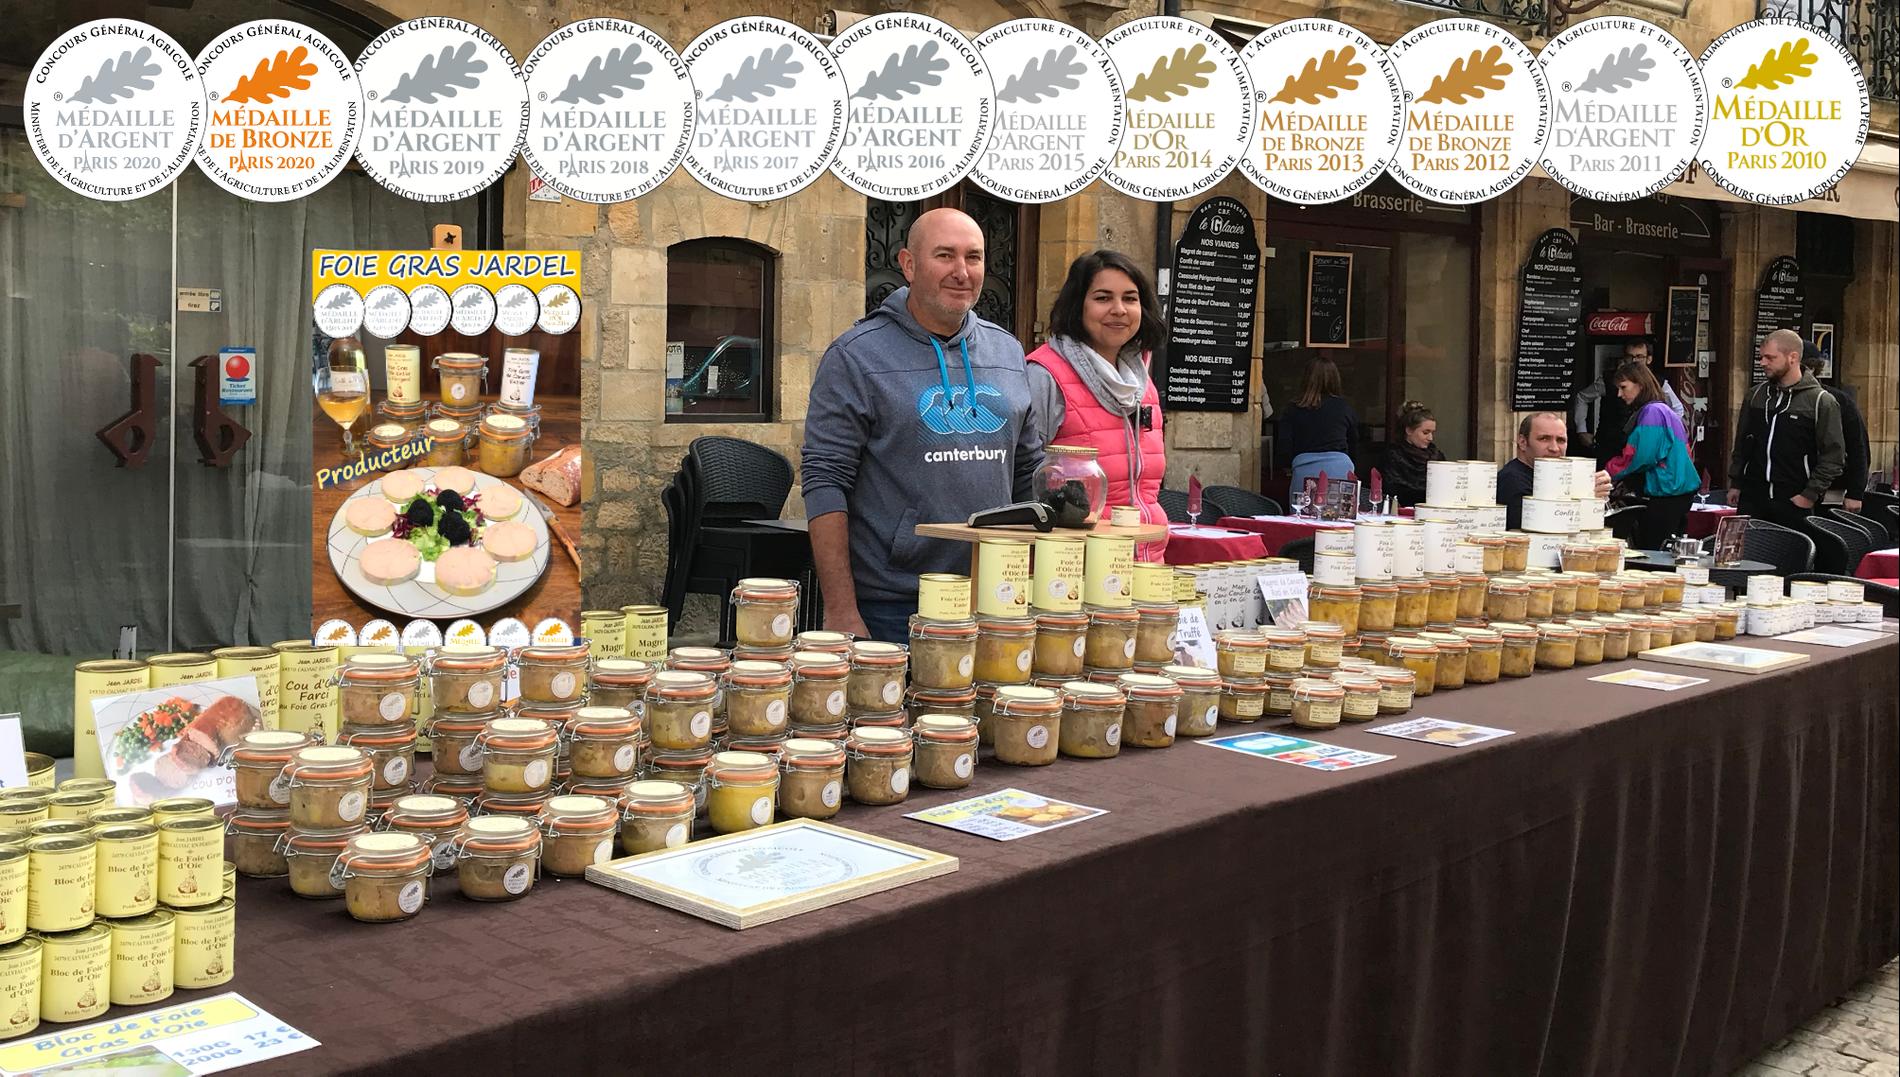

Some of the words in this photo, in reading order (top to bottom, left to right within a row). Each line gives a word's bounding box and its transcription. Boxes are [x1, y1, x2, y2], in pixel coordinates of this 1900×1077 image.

[1200, 203, 1212, 213] BAR
[1218, 201, 1248, 218] BRASSERIE
[1352, 192, 1423, 213] Brasserie
[1594, 213, 1615, 232] Bar
[1625, 217, 1678, 238] Brasserie
[1200, 238, 1214, 247] NOS
[1214, 240, 1240, 249] VIANDES
[320, 255, 378, 277] FOIE
[389, 255, 460, 277] GRAS
[470, 255, 575, 277] JARDEL
[1184, 354, 1198, 362] NOS
[1198, 355, 1233, 365] OMELETTES
[316, 436, 436, 489] Producteur
[924, 445, 1007, 464] canterbury
[285, 681, 309, 691] Cou
[299, 691, 329, 701] Farci
[290, 702, 307, 711] Foie
[310, 701, 328, 710] Gras
[180, 937, 198, 945] Bloc
[201, 937, 212, 945] de
[116, 954, 136, 962] Bloc
[137, 953, 149, 961] de
[50, 969, 70, 977] Bloc
[72, 968, 84, 976] de
[86, 965, 104, 975] Foie
[77, 973, 102, 984] d'Oie
[33, 1032, 96, 1051] Bloc
[107, 1021, 141, 1035] de
[150, 1007, 205, 1025] Foie
[59, 1036, 129, 1058] Gras
[139, 1018, 209, 1041] d'Oie
[171, 1040, 231, 1058] 130G
[243, 1030, 267, 1042] 17
[276, 1025, 292, 1033] €
[184, 1047, 243, 1067] 200G
[255, 1038, 283, 1050] 23
[287, 1032, 304, 1041] €
